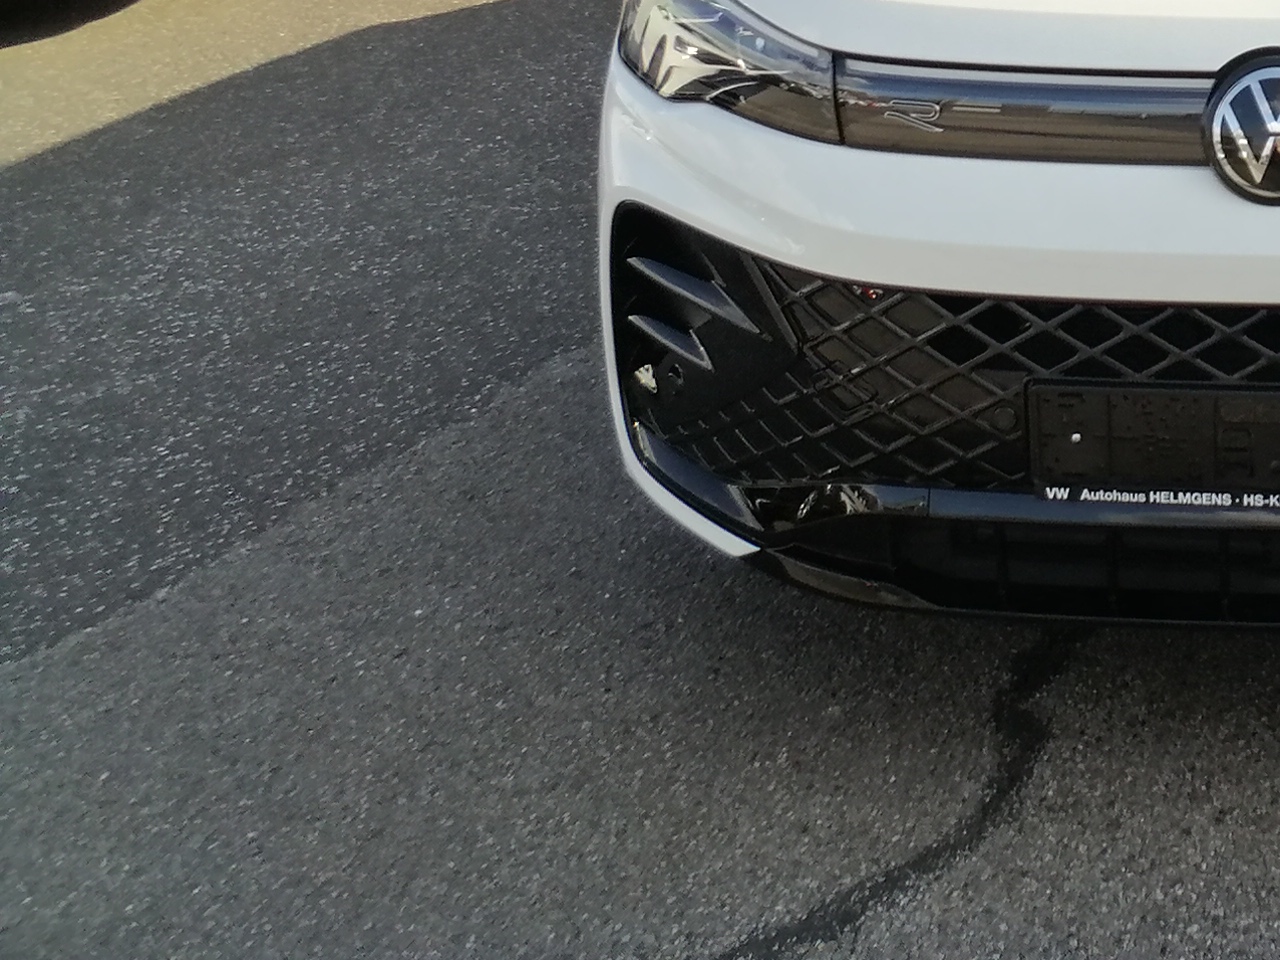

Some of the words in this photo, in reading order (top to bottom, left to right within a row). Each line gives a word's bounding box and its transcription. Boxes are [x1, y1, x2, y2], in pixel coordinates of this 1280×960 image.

[1045, 487, 1070, 500] VW
[1080, 489, 1147, 503] Autohaus
[1149, 491, 1232, 506] HELMGENS
